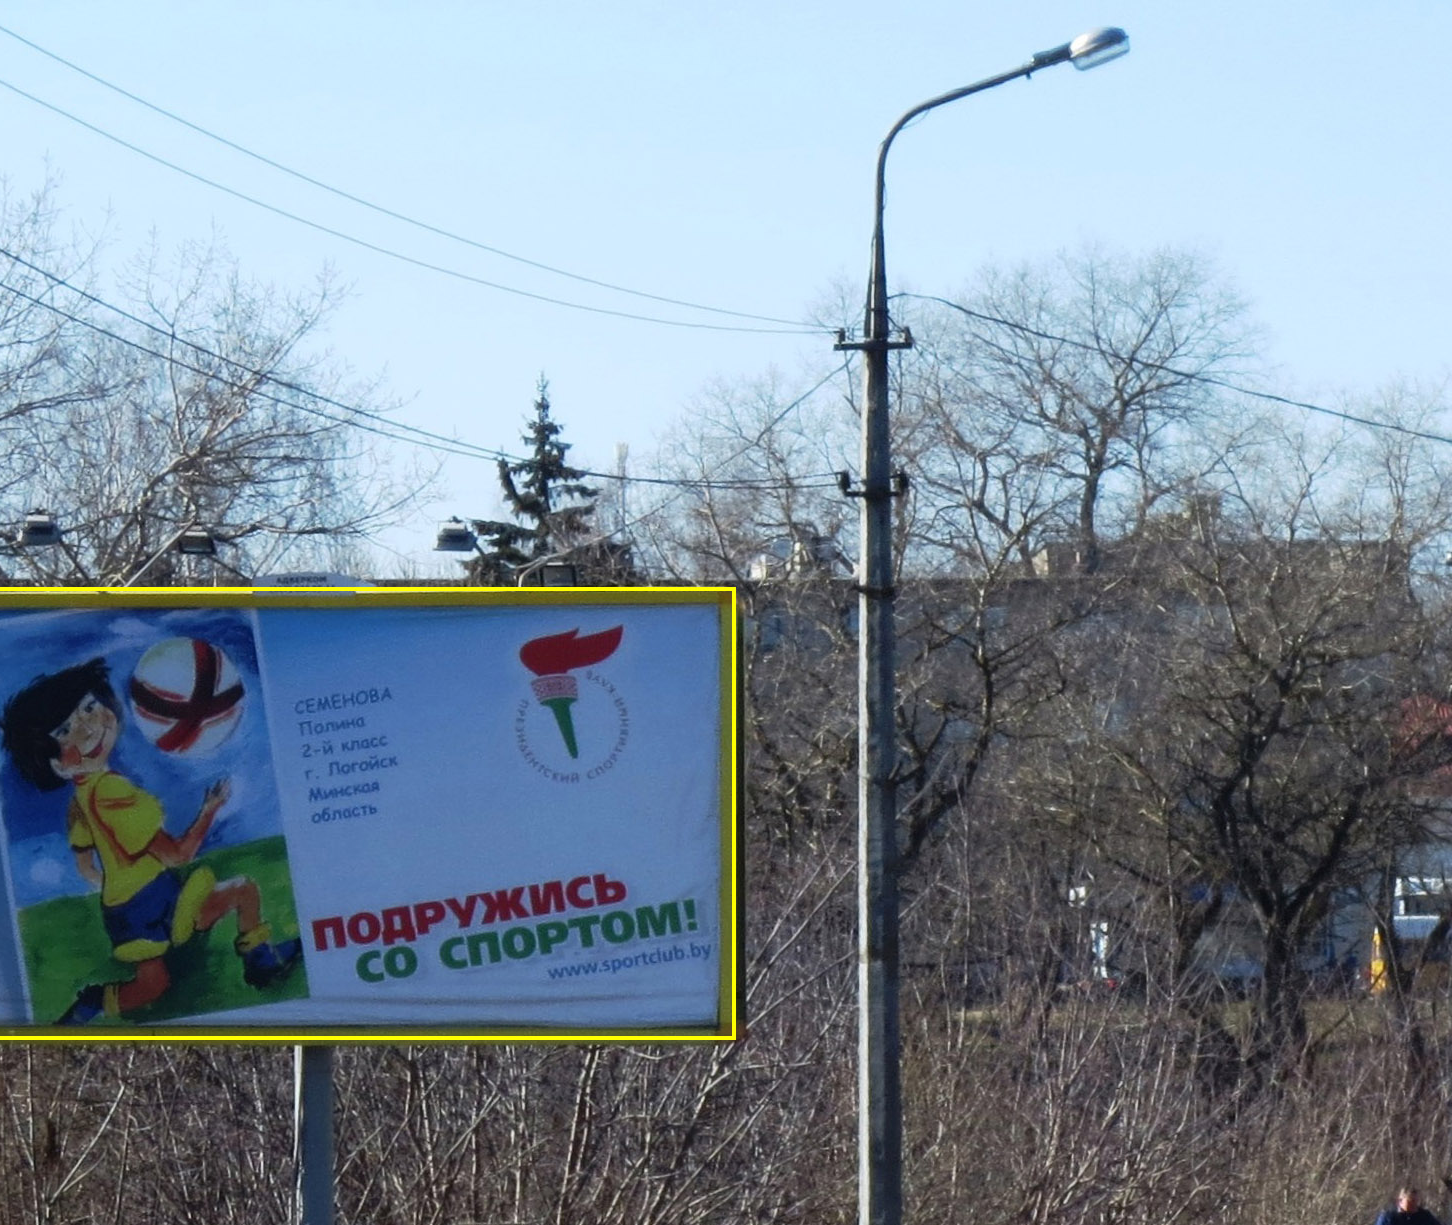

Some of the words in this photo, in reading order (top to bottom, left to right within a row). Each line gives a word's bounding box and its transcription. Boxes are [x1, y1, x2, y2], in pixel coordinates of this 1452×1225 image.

[294, 688, 393, 715] СЕМЕНОВА
[299, 716, 367, 737] Полина
[301, 740, 334, 759] 2-й
[341, 735, 389, 753] класс
[304, 769, 321, 781] г.
[328, 755, 399, 777] Логойск
[308, 780, 381, 803] Минская
[311, 803, 378, 824] область
[311, 872, 628, 952] ПОДРУЖИСЬ
[355, 944, 419, 984] СО
[438, 898, 700, 971] СПОРТОМ!
[547, 940, 713, 980] www.sportclub.by
